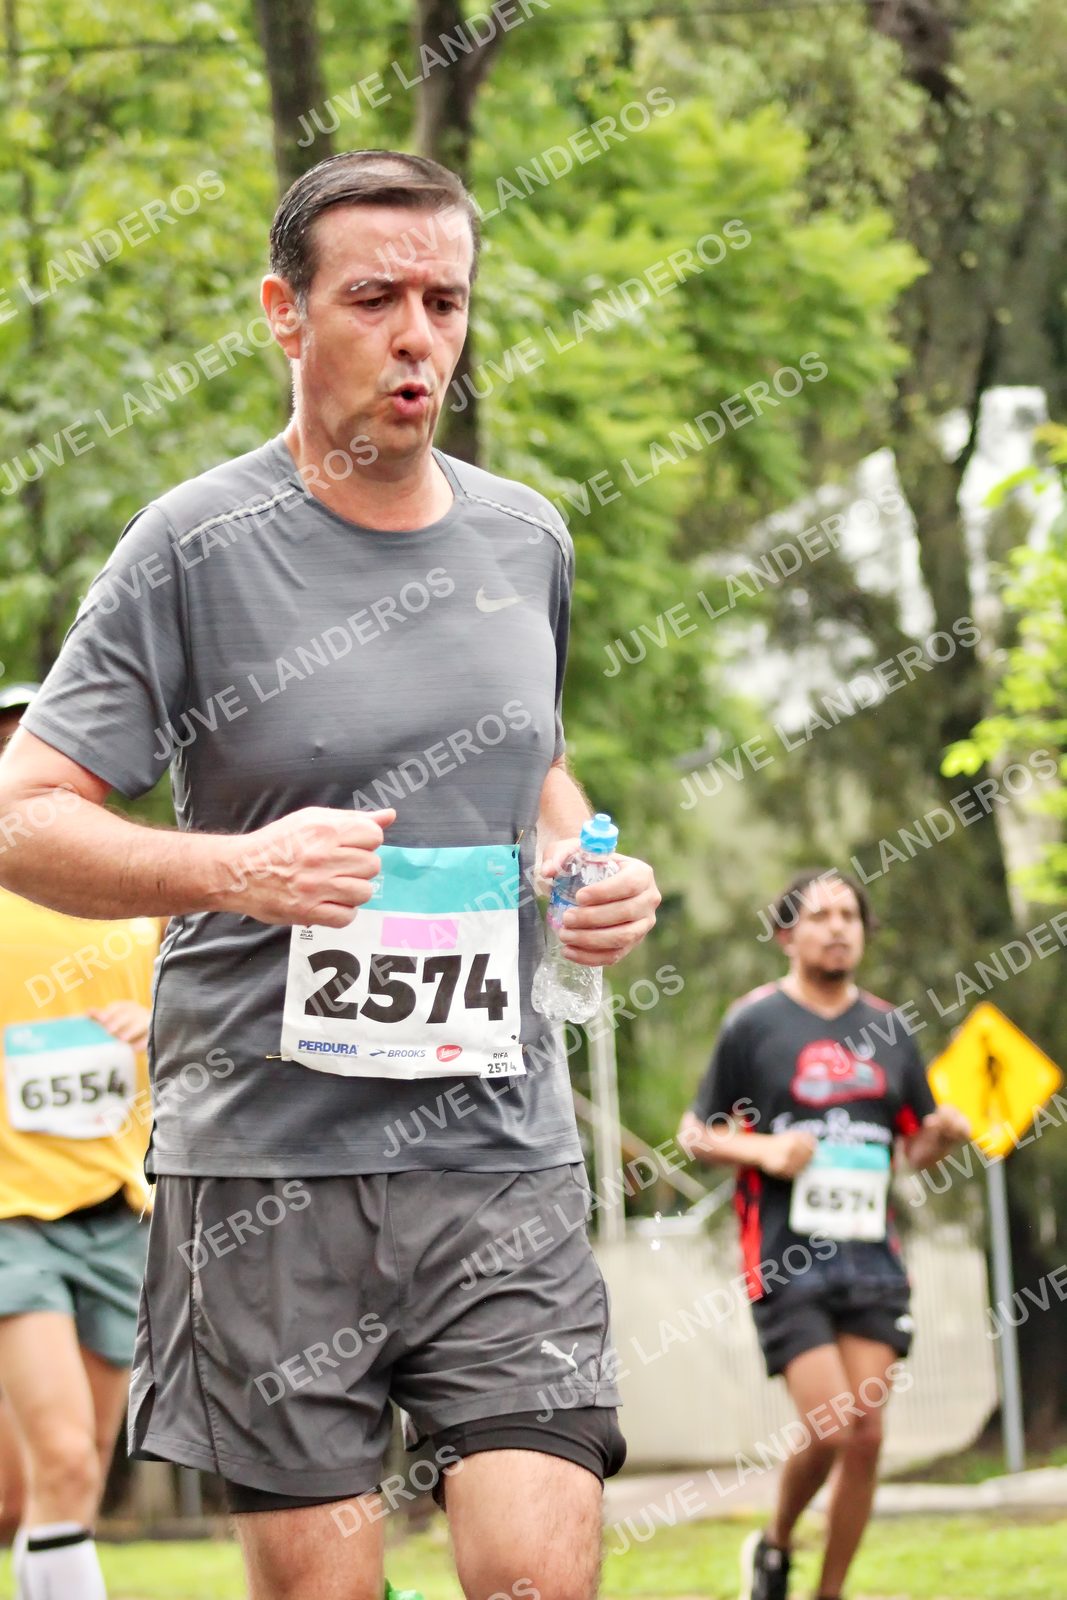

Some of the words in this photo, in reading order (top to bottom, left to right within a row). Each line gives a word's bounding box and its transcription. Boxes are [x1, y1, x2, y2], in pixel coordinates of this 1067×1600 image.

[304, 949, 508, 1024] 2574
[298, 1039, 358, 1056] PERDURA
[387, 1049, 426, 1058] BROOKS
[492, 1052, 509, 1060] RIFA
[487, 1062, 517, 1074] 2574
[20, 1067, 127, 1111] 6554
